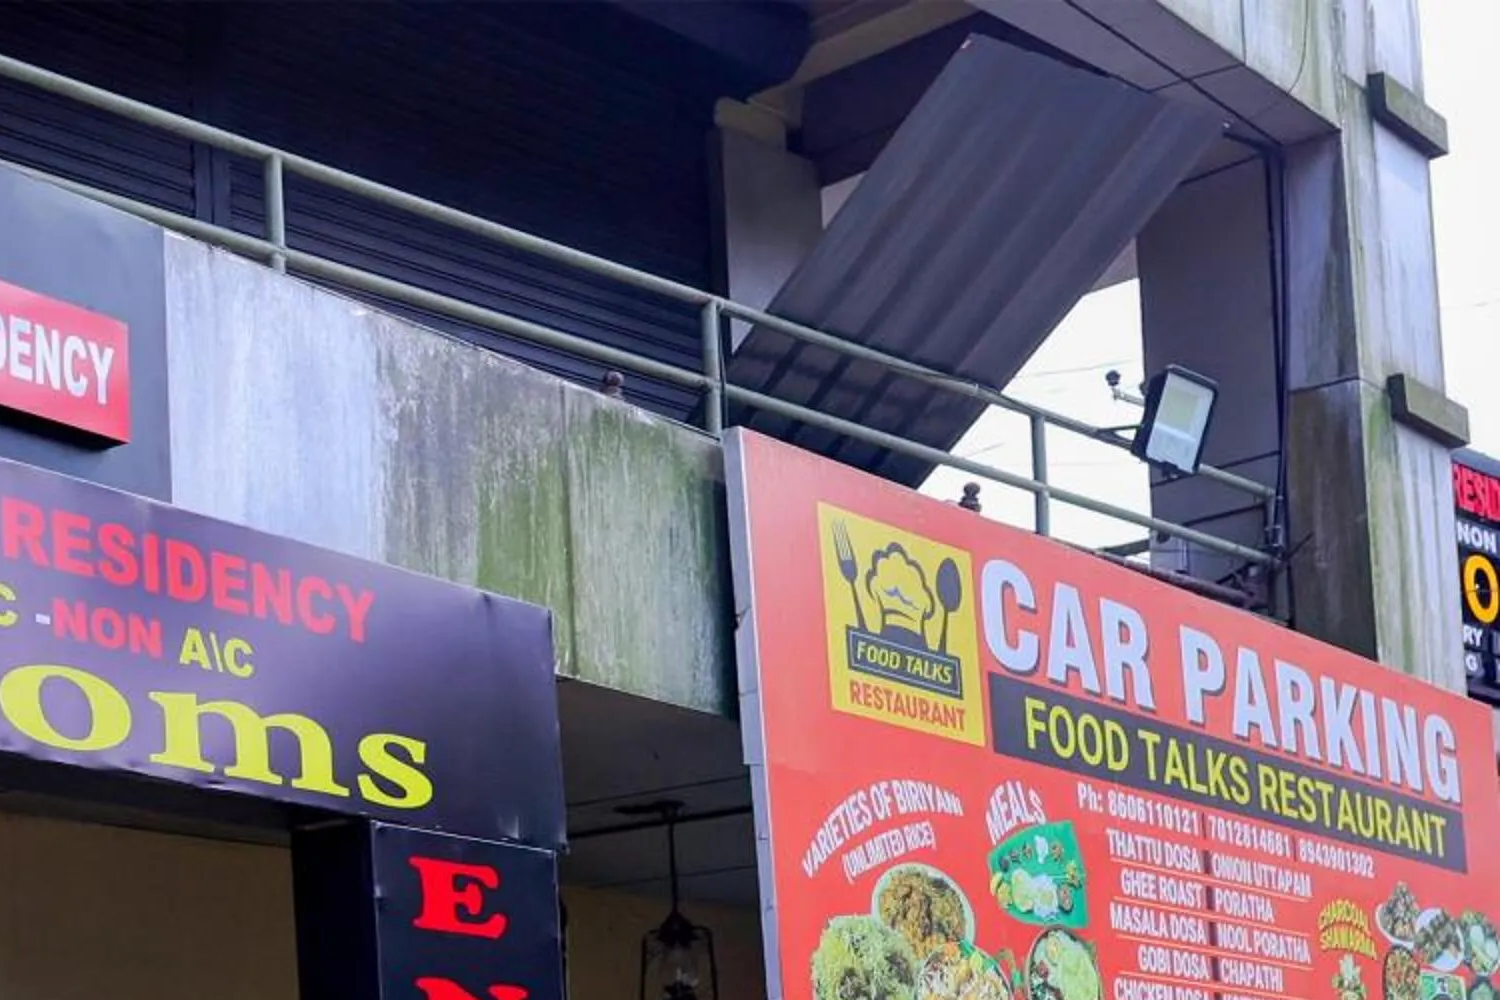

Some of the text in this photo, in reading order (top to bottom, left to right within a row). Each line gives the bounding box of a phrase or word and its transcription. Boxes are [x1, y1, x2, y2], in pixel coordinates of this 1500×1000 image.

[1457, 519, 1497, 554] NON
[0, 495, 376, 644] RESIDENCY
[857, 640, 953, 685] FOOD TALKS
[981, 559, 1461, 804] CAR PARKING
[850, 679, 965, 731] RESTAURANT
[1024, 697, 1448, 859] FOOD TALKS RESTAURANT
[1077, 782, 1103, 813] Ph:
[802, 790, 873, 878] VARIETIES
[869, 780, 894, 821] OF
[985, 780, 1046, 845] MEALS
[1105, 826, 1202, 873] THATTU DOSA
[1121, 868, 1202, 909] GHEE ROAST
[1215, 886, 1275, 923] PORATHA
[1110, 901, 1208, 946] MASALA DOSA
[1138, 943, 1211, 981] GOBI DOSA
[1253, 930, 1312, 965] PORATHA
[1221, 958, 1284, 992] CHAPATHI
